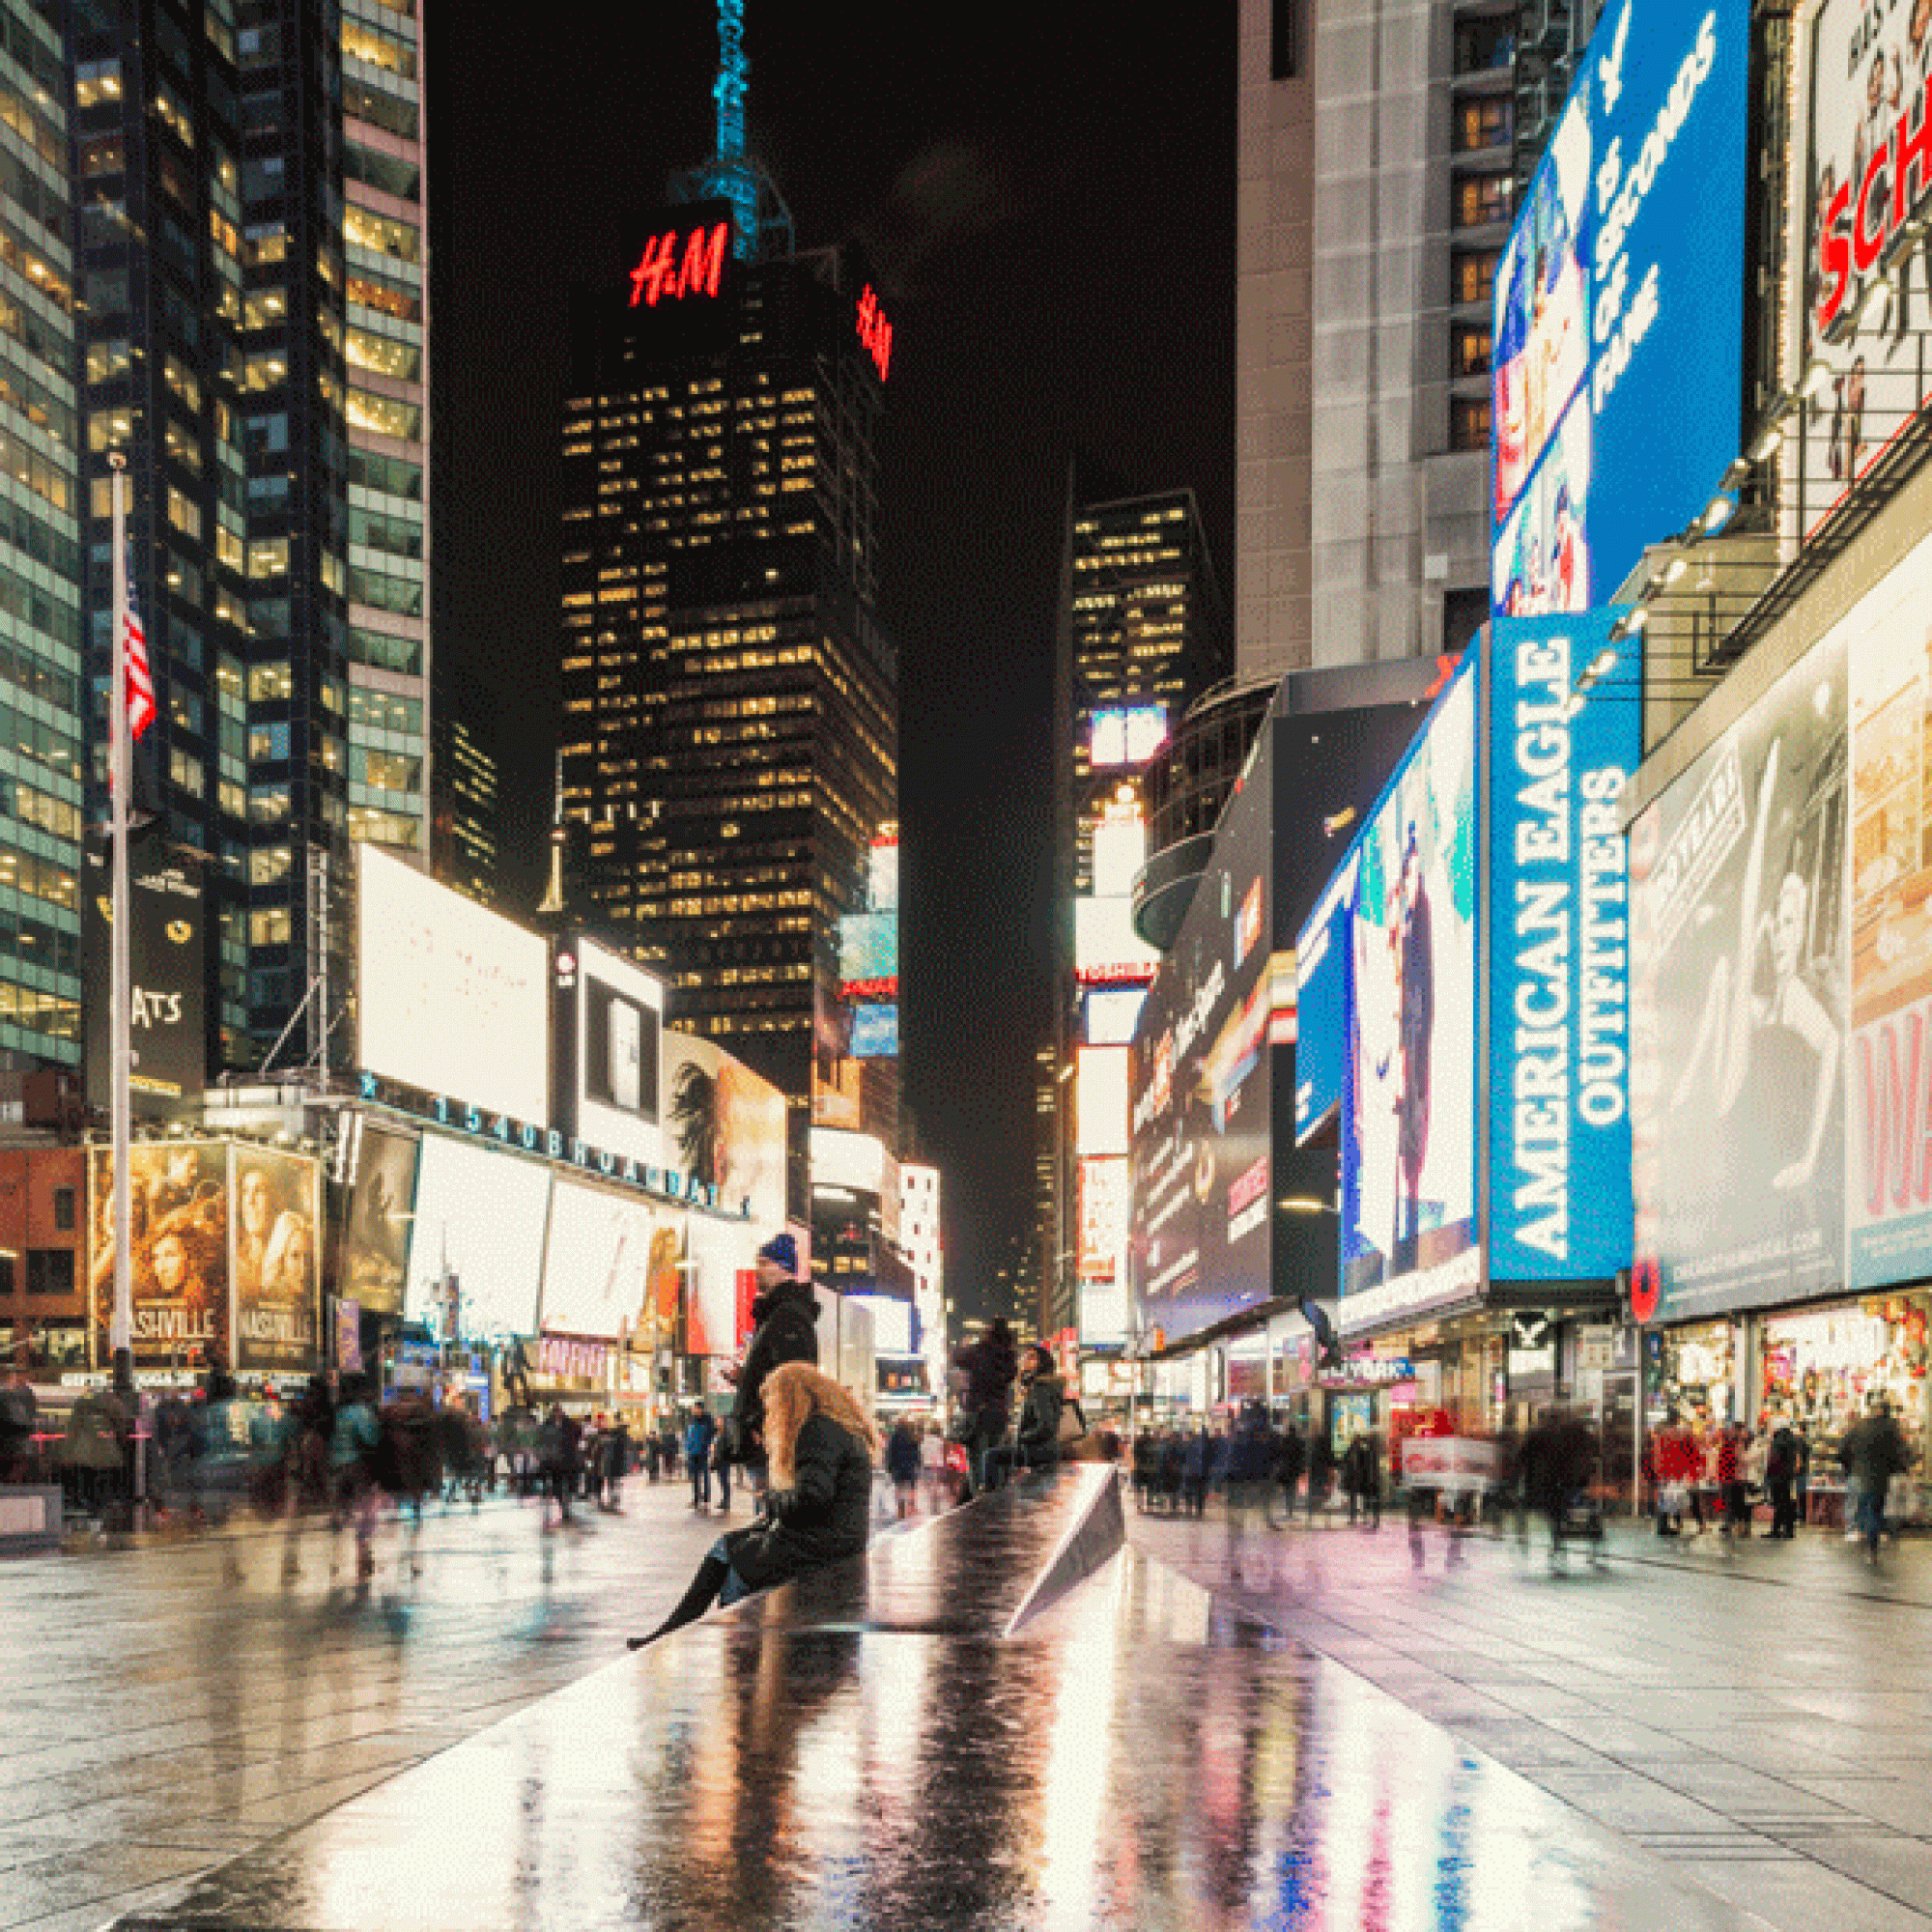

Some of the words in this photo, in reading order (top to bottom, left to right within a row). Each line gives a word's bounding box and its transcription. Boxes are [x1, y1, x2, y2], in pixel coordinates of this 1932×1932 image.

[630, 223, 727, 305] H&M
[1514, 638, 1573, 865] EAGLE
[131, 985, 183, 1029] ATS
[1579, 765, 1629, 1125] OUTFITTERS
[1514, 880, 1571, 1261] AMERICAN
[130, 1309, 216, 1339] ASHVILLE
